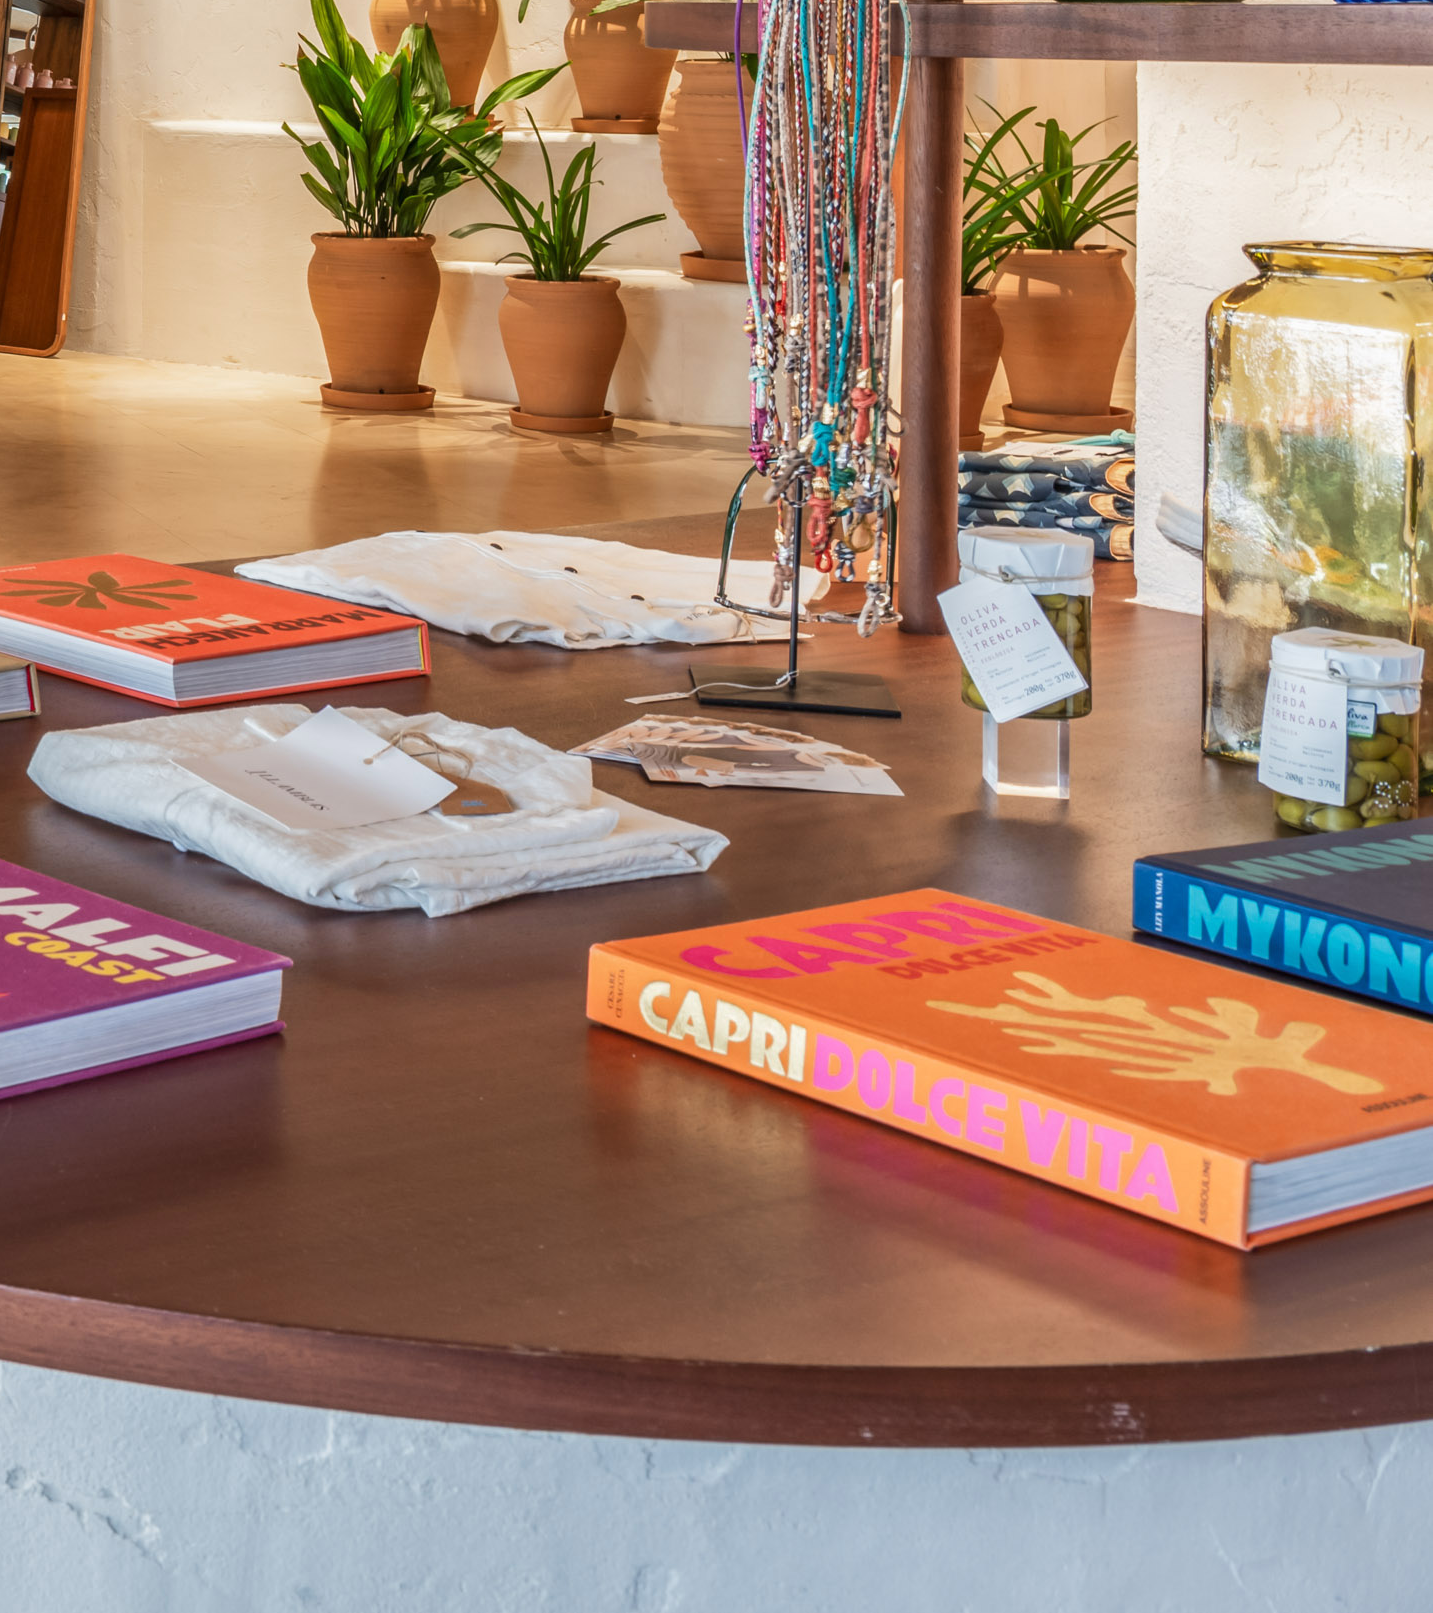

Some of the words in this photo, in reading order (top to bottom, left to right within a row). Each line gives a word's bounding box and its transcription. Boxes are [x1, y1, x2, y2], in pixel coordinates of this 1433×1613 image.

[100, 613, 263, 640] FLAIR
[136, 609, 383, 650] MARRAKECH
[961, 602, 999, 626] OLIVA
[967, 616, 1007, 638] VERDA
[974, 618, 1041, 652] TRENCADA
[1271, 707, 1337, 730] TRENCADA
[3, 931, 167, 986] COAST
[679, 901, 1050, 979] CAPRI
[877, 948, 1013, 980] DOLCE
[994, 933, 1100, 957] VITA
[1188, 884, 1433, 1005] MYKON
[638, 981, 807, 1082] CAPRI
[813, 1033, 1007, 1154] DOLCE
[1019, 1099, 1180, 1214] VITA
